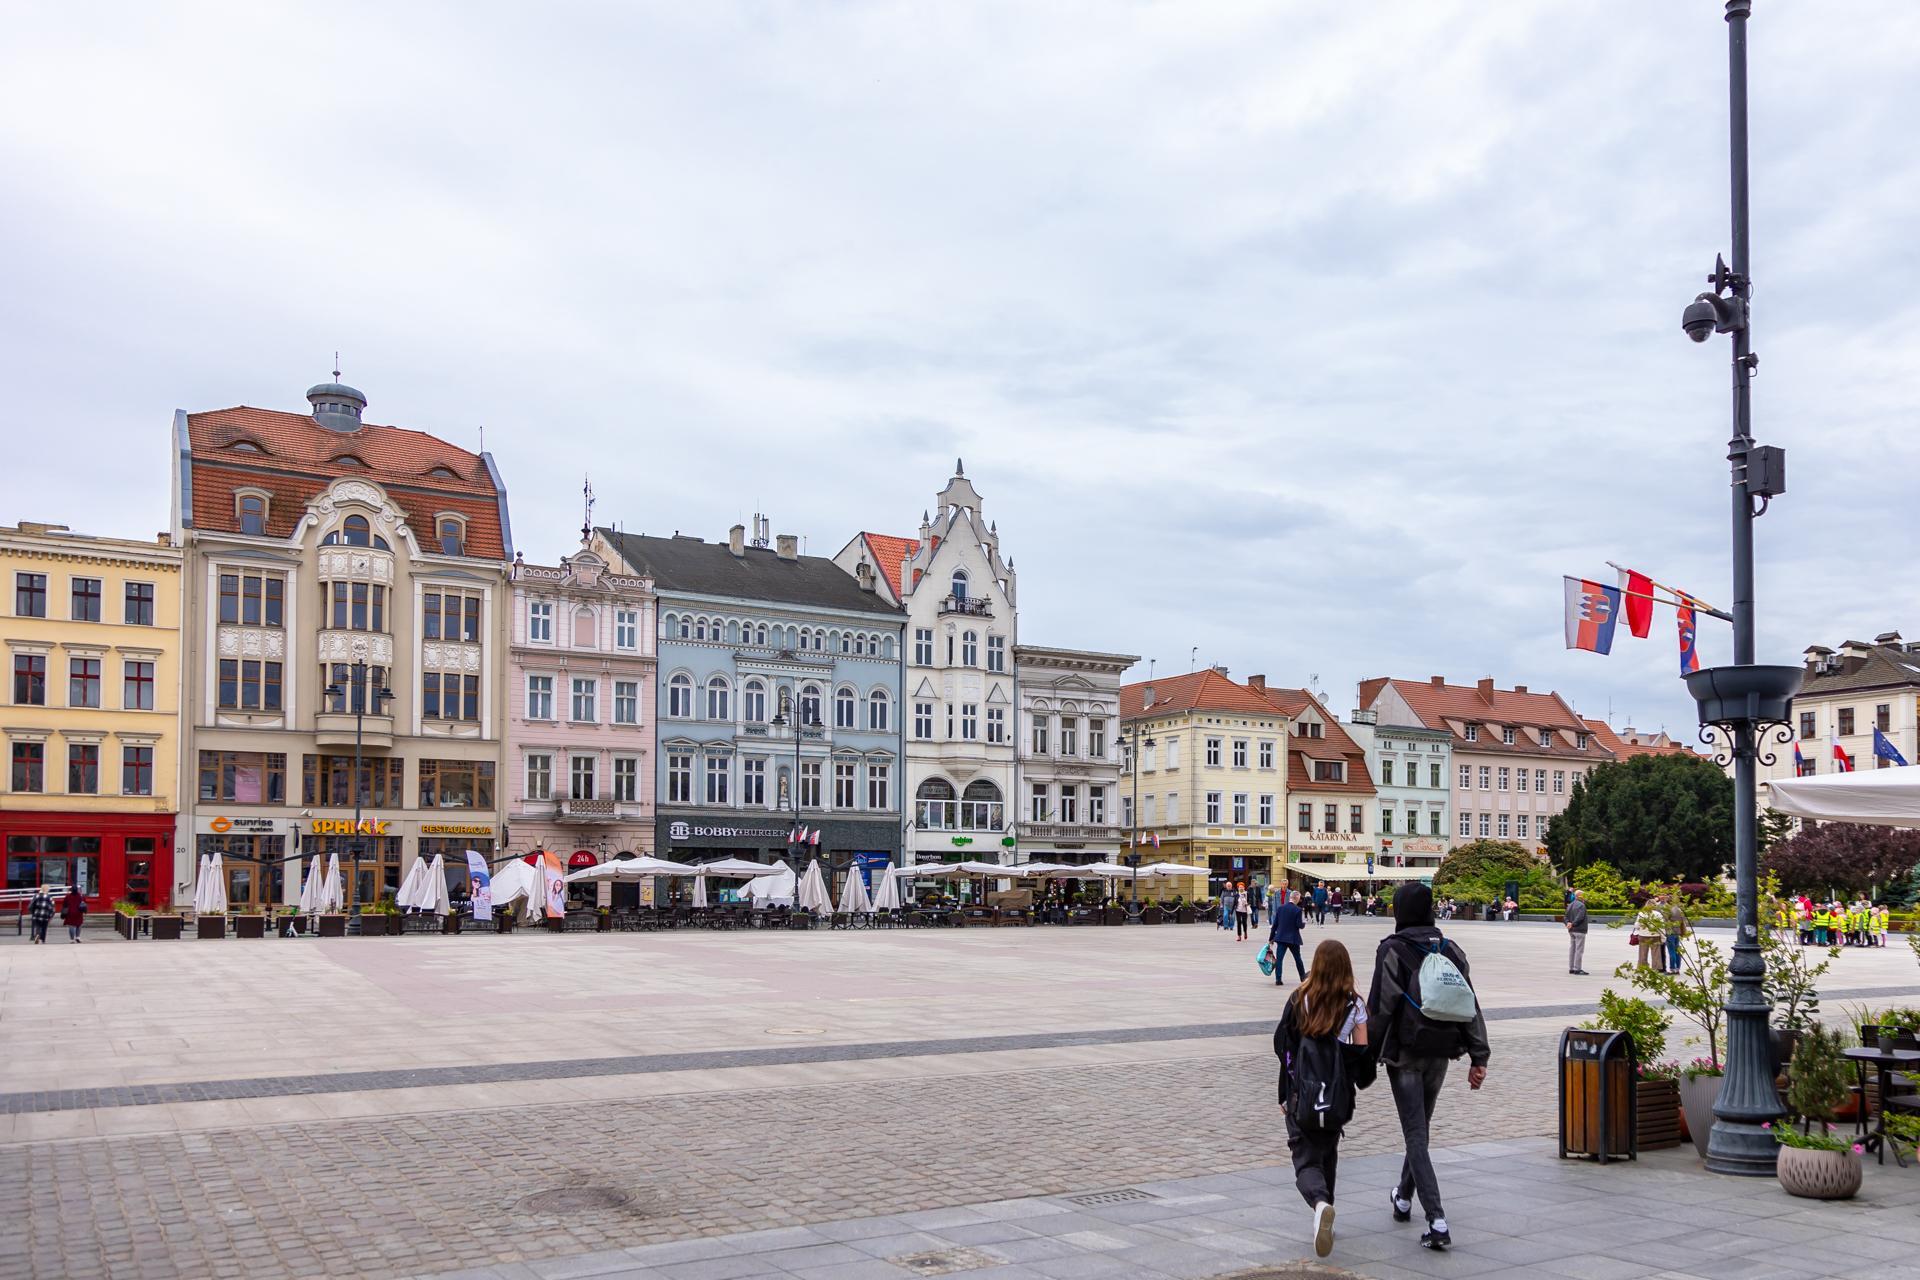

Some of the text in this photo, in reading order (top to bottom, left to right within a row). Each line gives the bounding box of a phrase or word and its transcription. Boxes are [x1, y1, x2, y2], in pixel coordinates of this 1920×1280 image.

[234, 818, 273, 826] sunrise
[422, 824, 492, 834] RESTAURACJA
[694, 826, 786, 837] BOBBY BURGER
[1309, 832, 1357, 841] KATARYNKA
